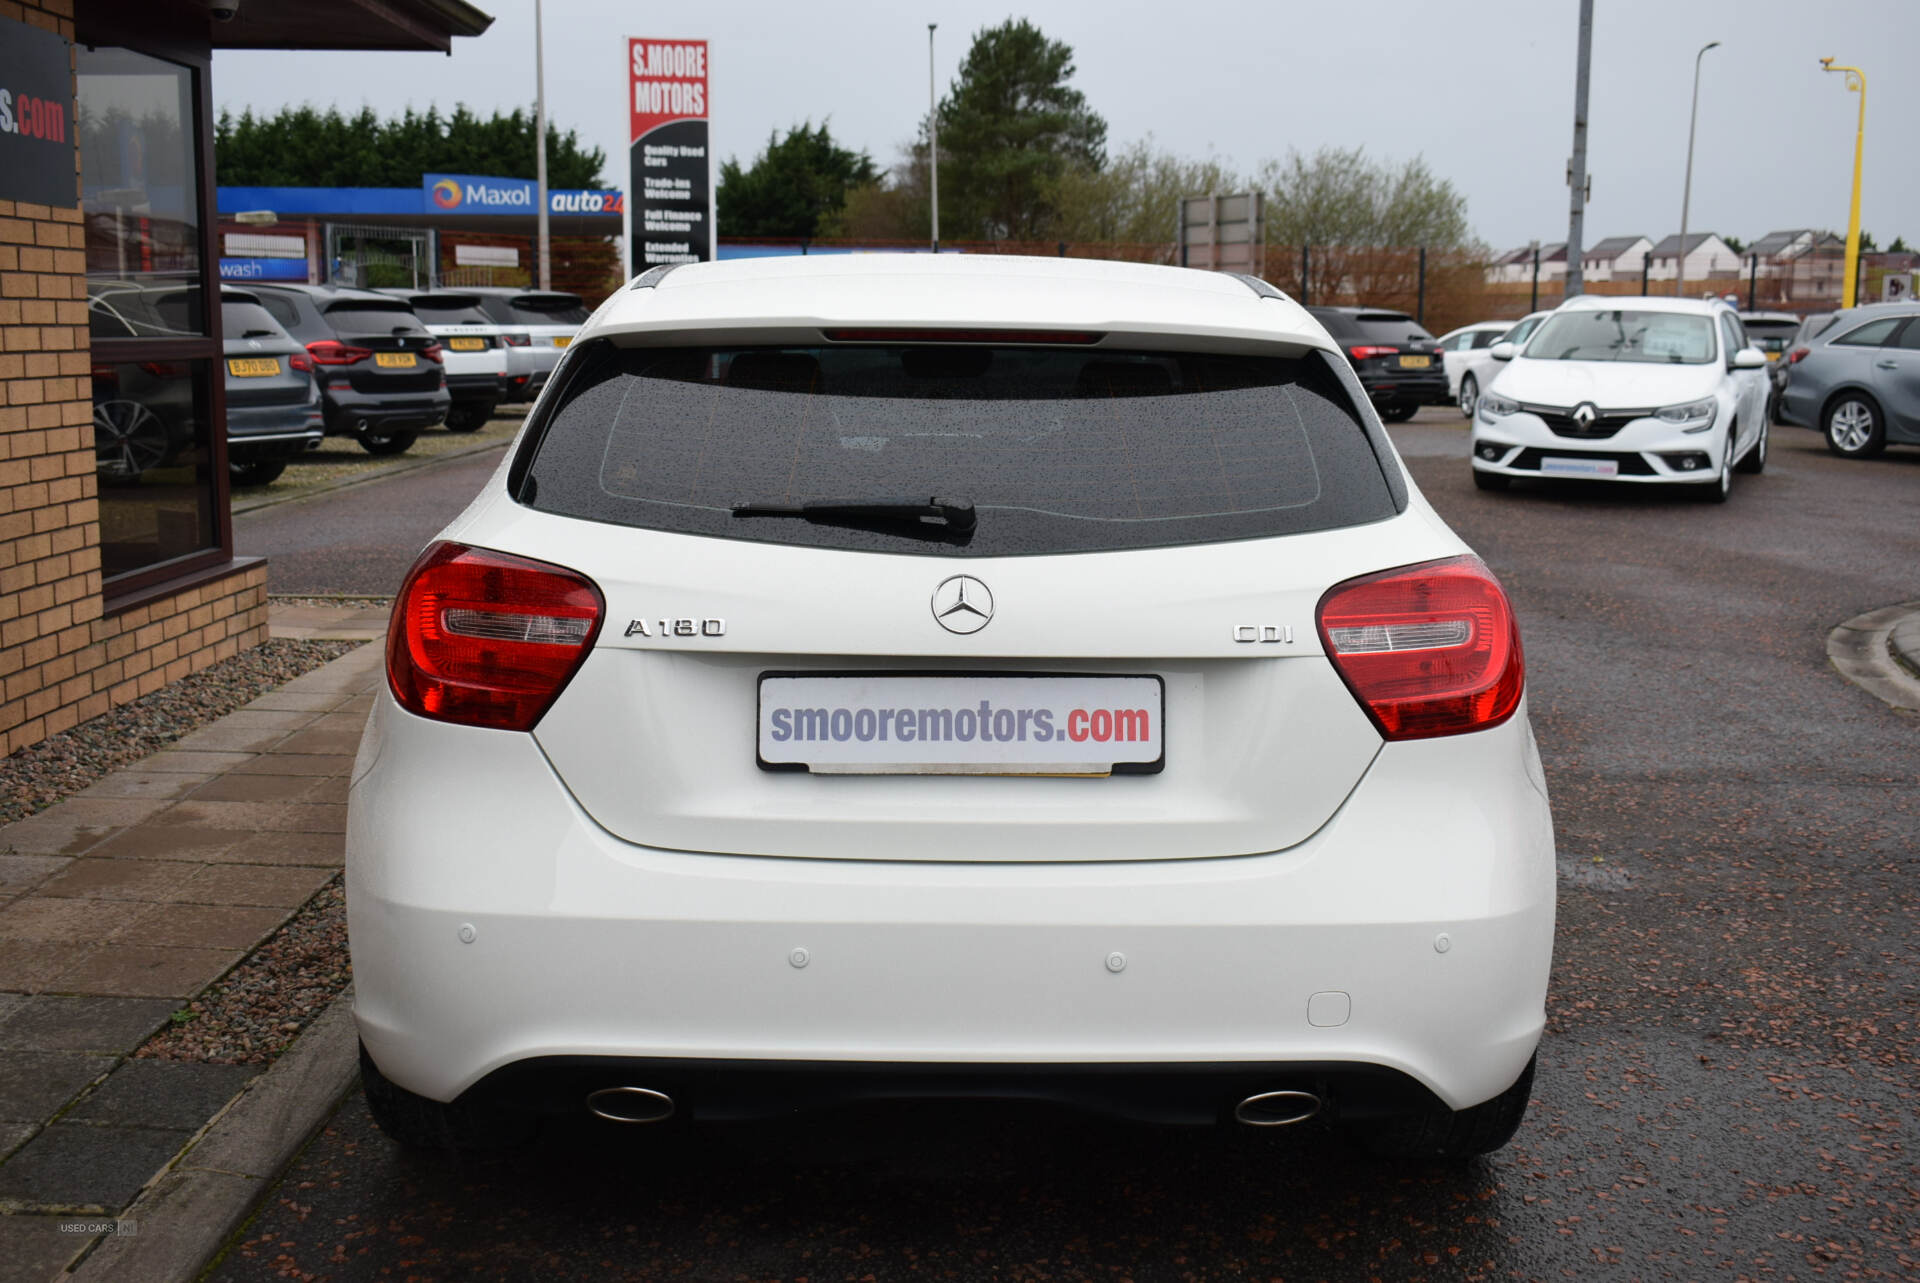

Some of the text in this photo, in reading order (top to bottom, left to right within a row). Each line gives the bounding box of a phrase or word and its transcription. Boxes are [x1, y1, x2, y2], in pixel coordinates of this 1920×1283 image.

[633, 43, 705, 77] S.MOORE
[635, 81, 704, 115] MOTORS
[644, 145, 704, 157] Quality Used
[644, 156, 668, 167] Cars
[467, 184, 531, 205] Maxol
[644, 189, 691, 200] Welcome
[645, 210, 702, 222] Full Finance
[645, 221, 691, 231] Welcome
[645, 241, 689, 253] Extended
[645, 252, 700, 263] Warranties
[220, 260, 262, 277] wash
[624, 618, 726, 637] A 180
[1233, 625, 1294, 644] CDI
[771, 700, 1149, 742] smooremotors.com
